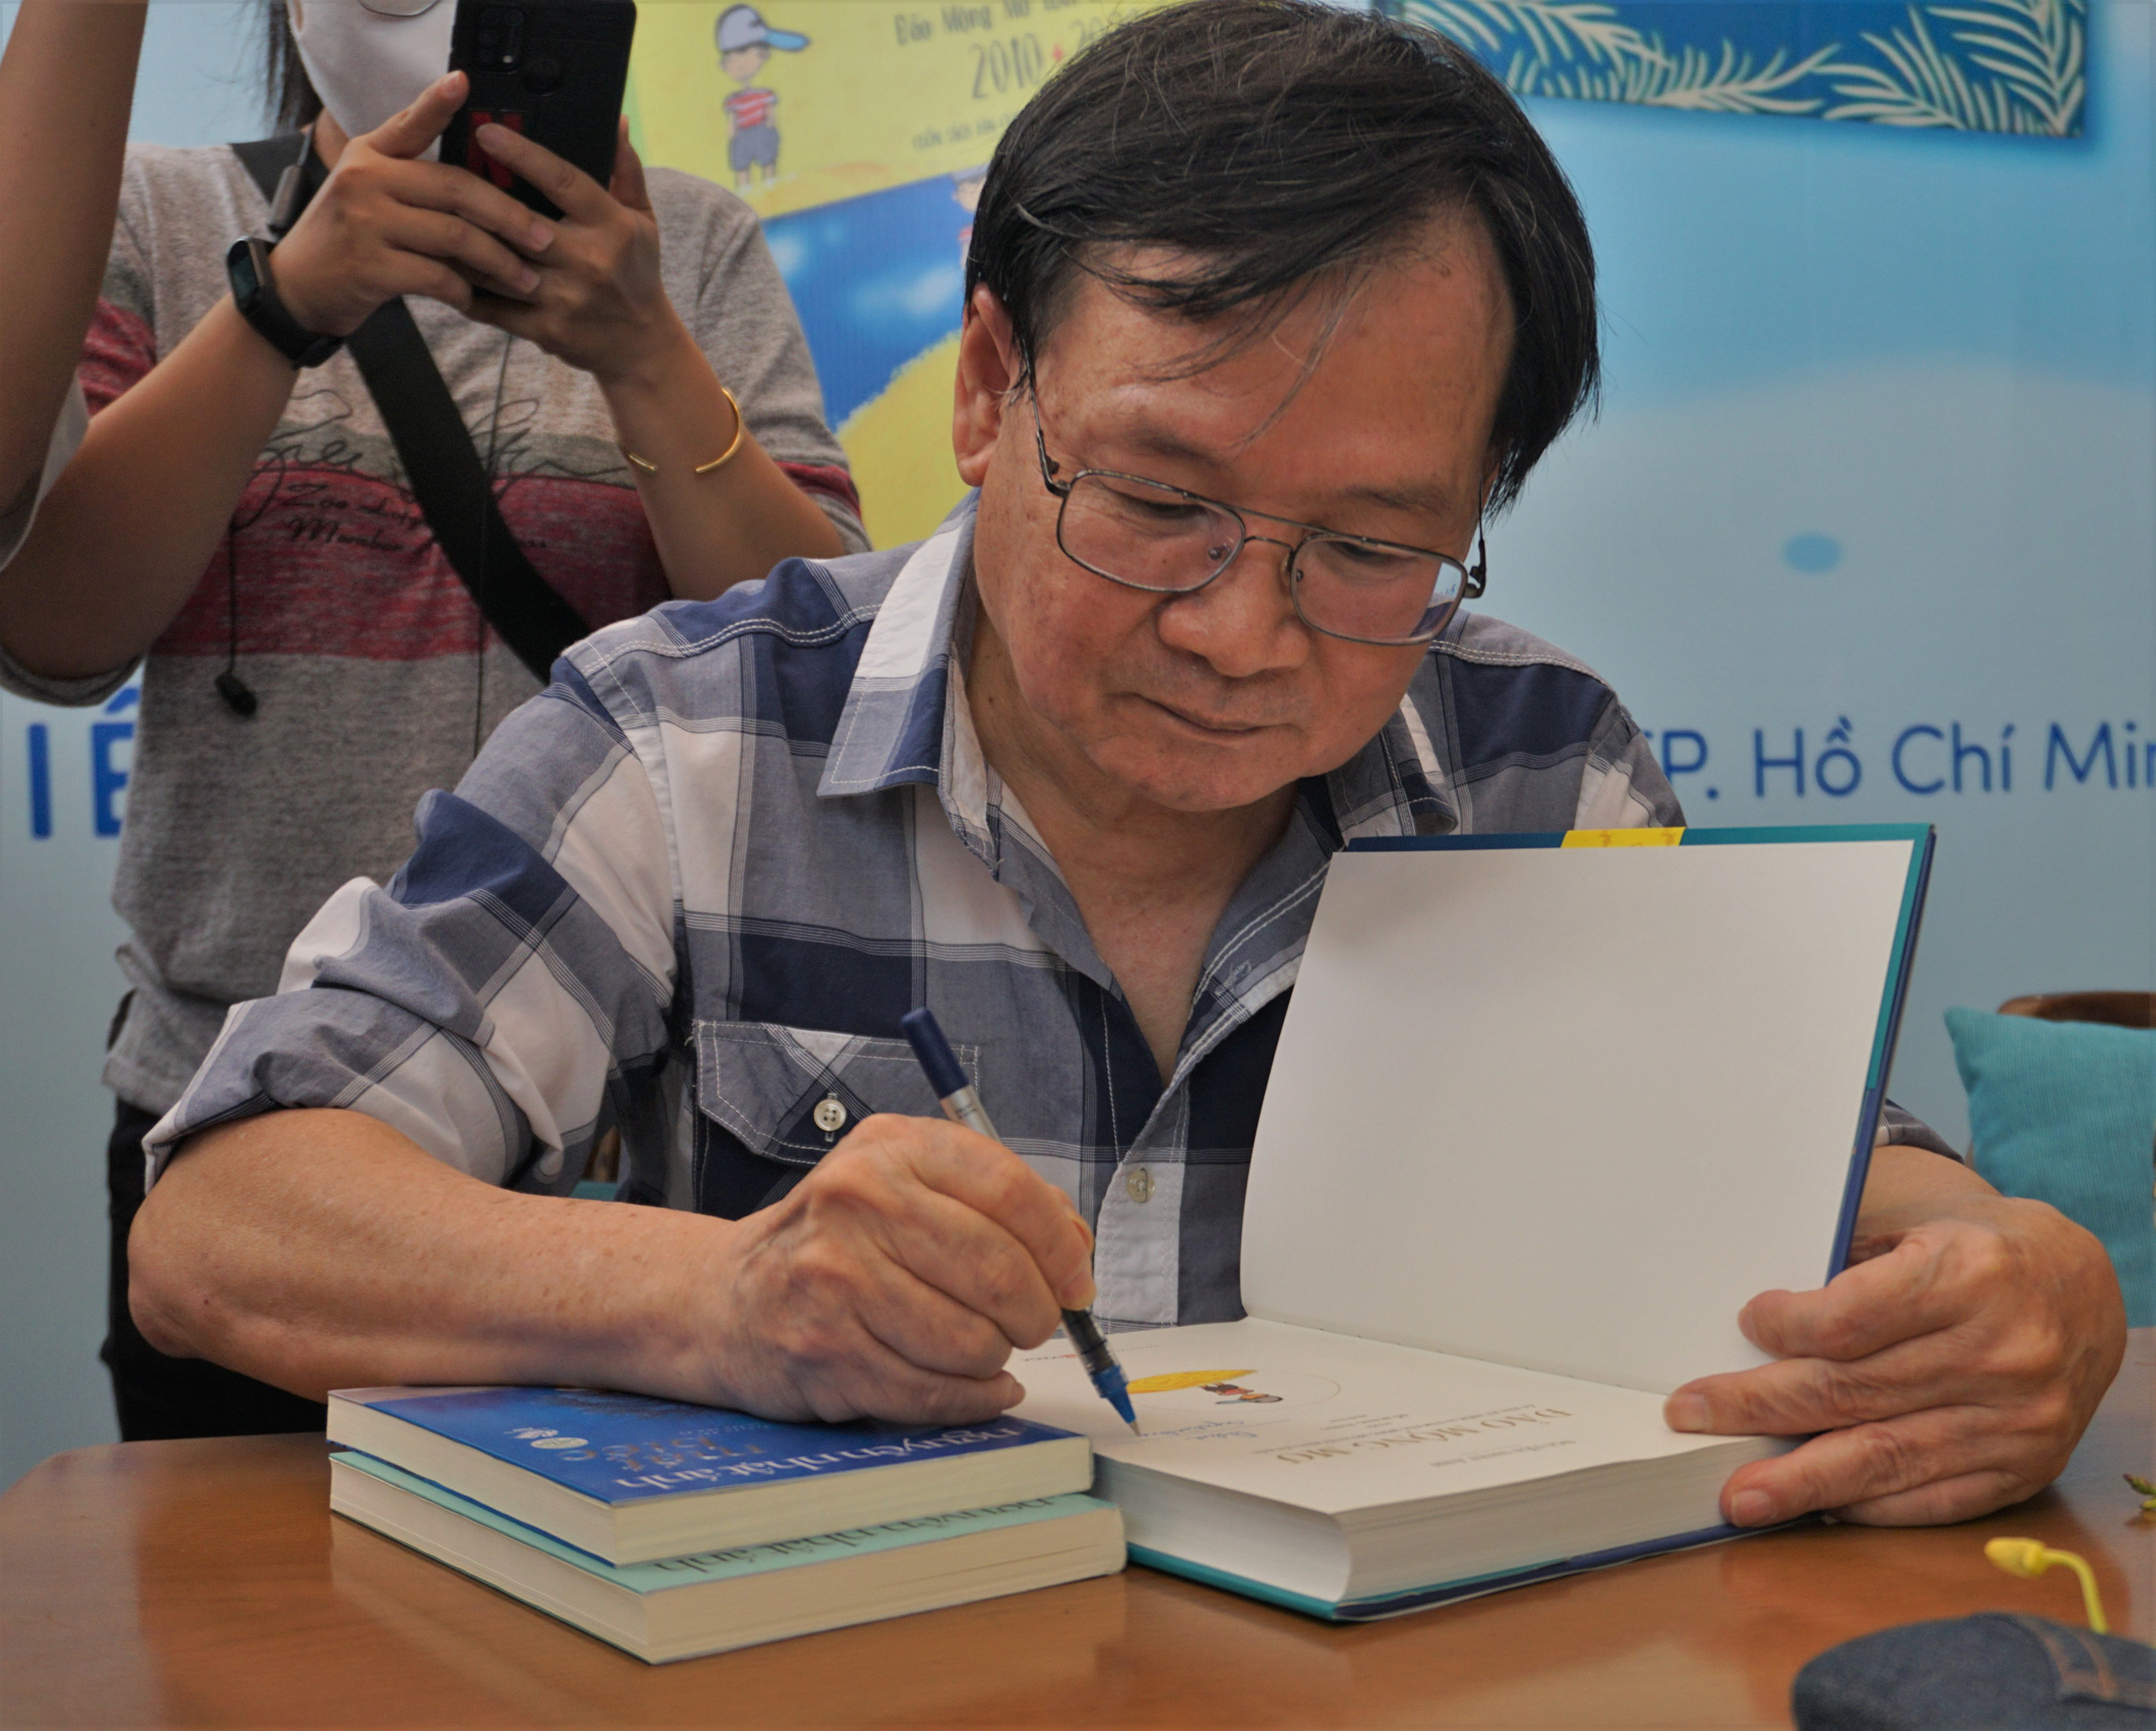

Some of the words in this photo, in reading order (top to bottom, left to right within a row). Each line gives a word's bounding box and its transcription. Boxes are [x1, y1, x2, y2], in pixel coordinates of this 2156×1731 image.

[971, 33, 1043, 99] 2010
[1645, 729, 1719, 800] P.
[1753, 715, 1862, 799] Hồ
[1891, 721, 2015, 796] Chí
